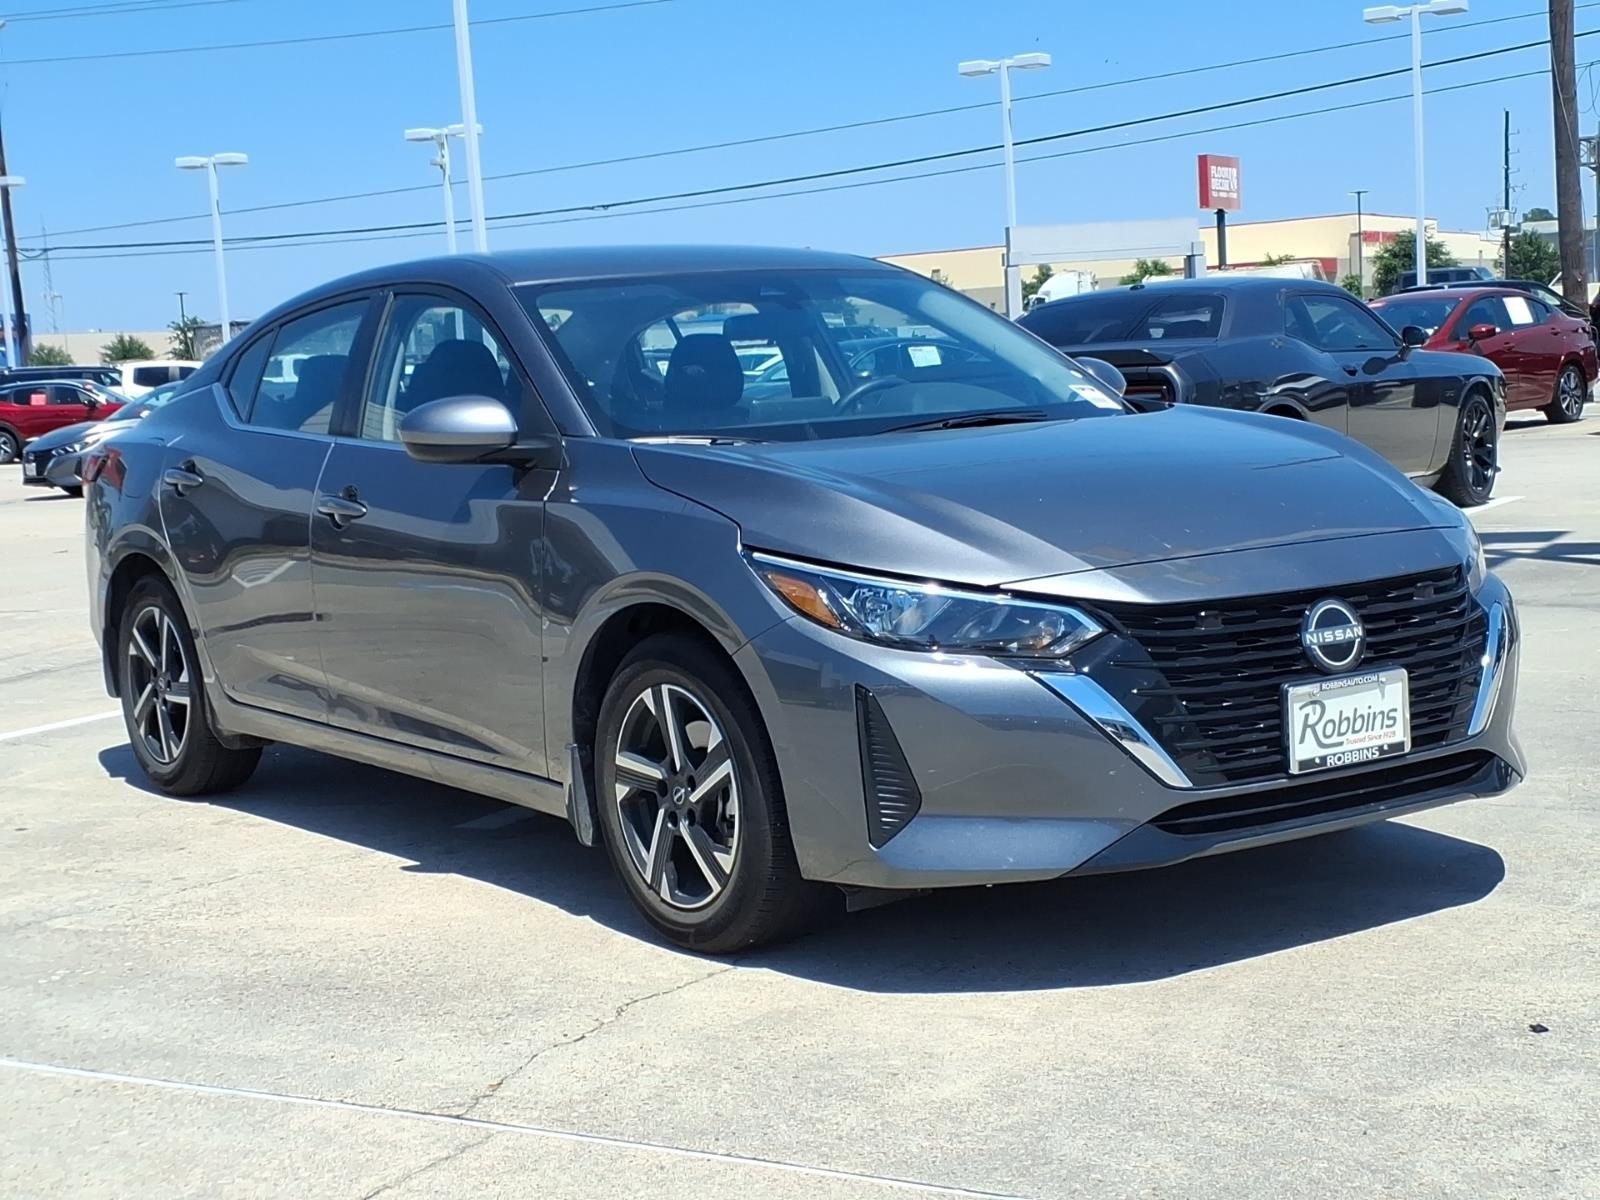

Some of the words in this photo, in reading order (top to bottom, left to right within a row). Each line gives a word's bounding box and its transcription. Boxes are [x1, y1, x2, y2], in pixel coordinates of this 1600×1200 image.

[1306, 626, 1362, 644] NISSAN
[1299, 699, 1398, 749] Robbins
[1328, 747, 1380, 766] ROBBINS
